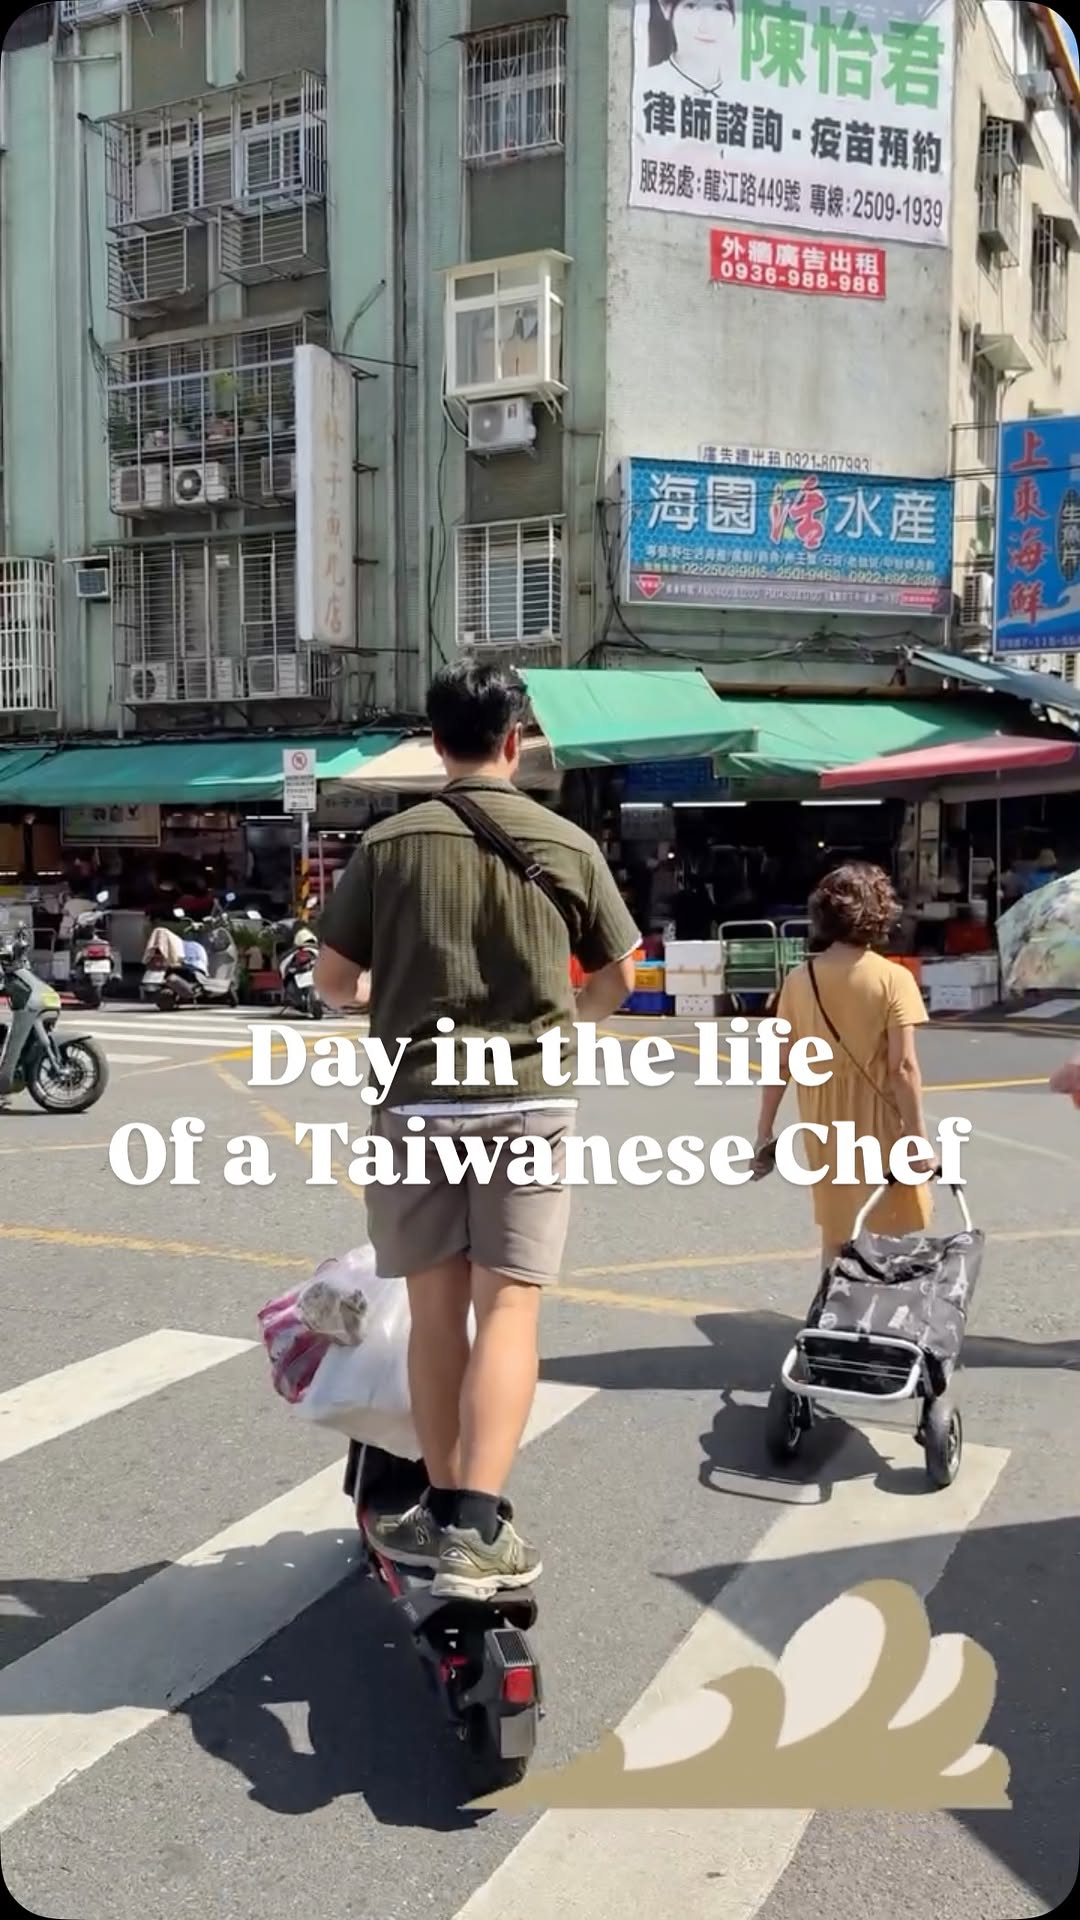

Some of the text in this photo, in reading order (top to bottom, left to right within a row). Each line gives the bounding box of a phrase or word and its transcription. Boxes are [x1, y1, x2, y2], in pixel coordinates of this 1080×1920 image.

[739, 0, 945, 109] 陳怡君
[720, 260, 880, 294] 0936-988-986
